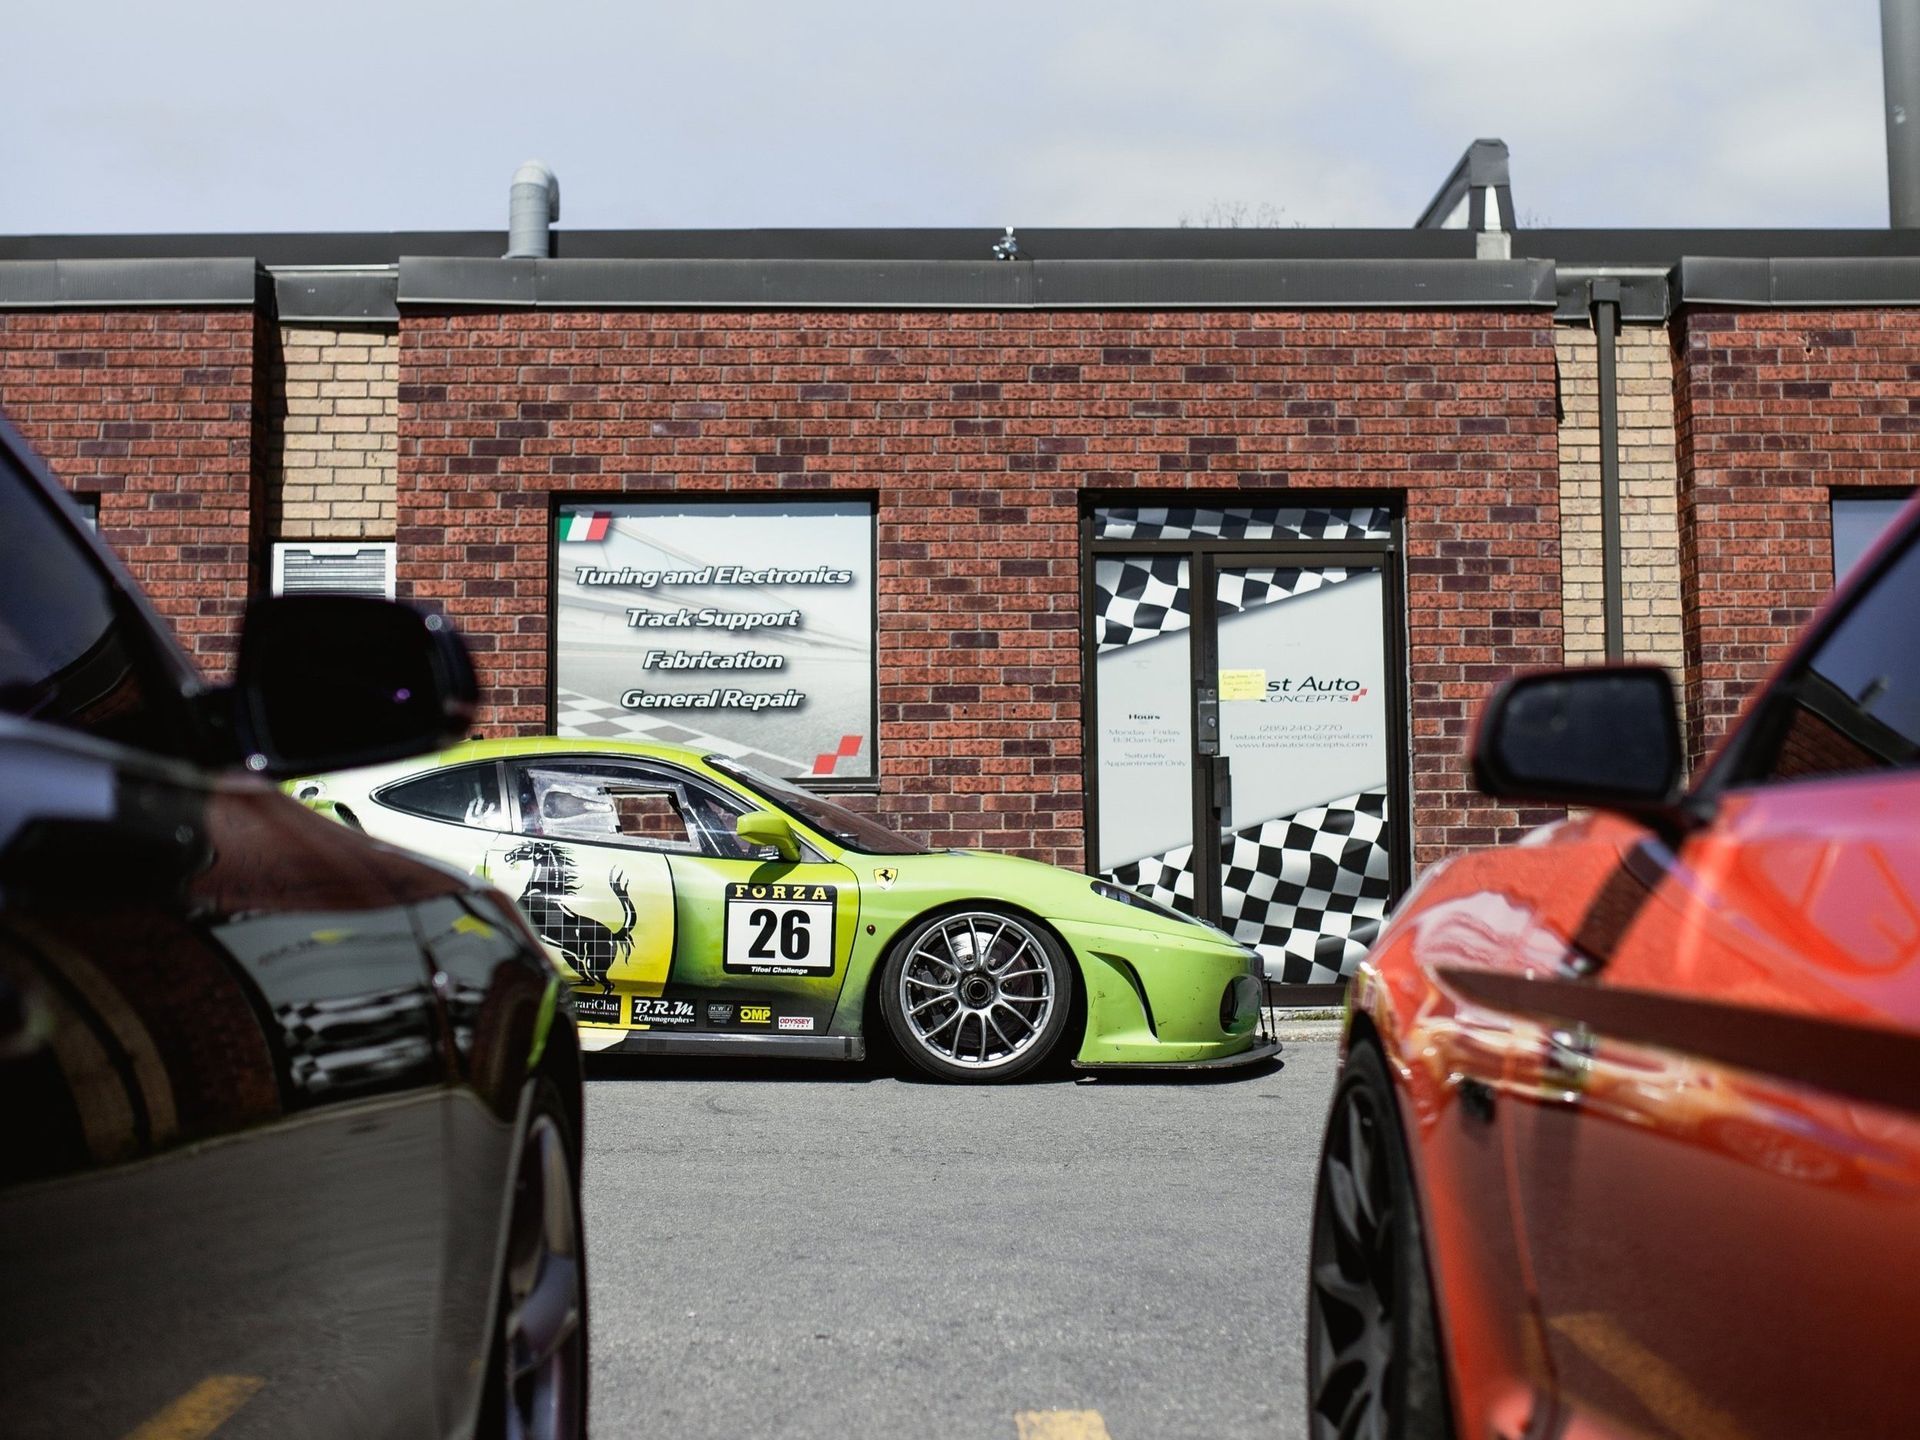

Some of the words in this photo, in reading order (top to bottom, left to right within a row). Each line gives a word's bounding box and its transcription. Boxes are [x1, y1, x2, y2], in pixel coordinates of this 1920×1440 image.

[577, 567, 661, 588] Tuning
[662, 567, 712, 585] and
[714, 566, 852, 585] Electronics
[627, 609, 692, 628] Track
[696, 609, 802, 630] Support
[643, 651, 784, 670] Fabrication
[1297, 676, 1360, 691] Auto
[620, 689, 720, 708] General
[720, 690, 806, 711] Repair
[1124, 752, 1166, 760] Saturday
[1105, 760, 1163, 768] Appointment
[735, 885, 827, 900] FORZA
[748, 908, 811, 960] 26
[772, 967, 808, 976] Challenge
[740, 1009, 771, 1020] OMP
